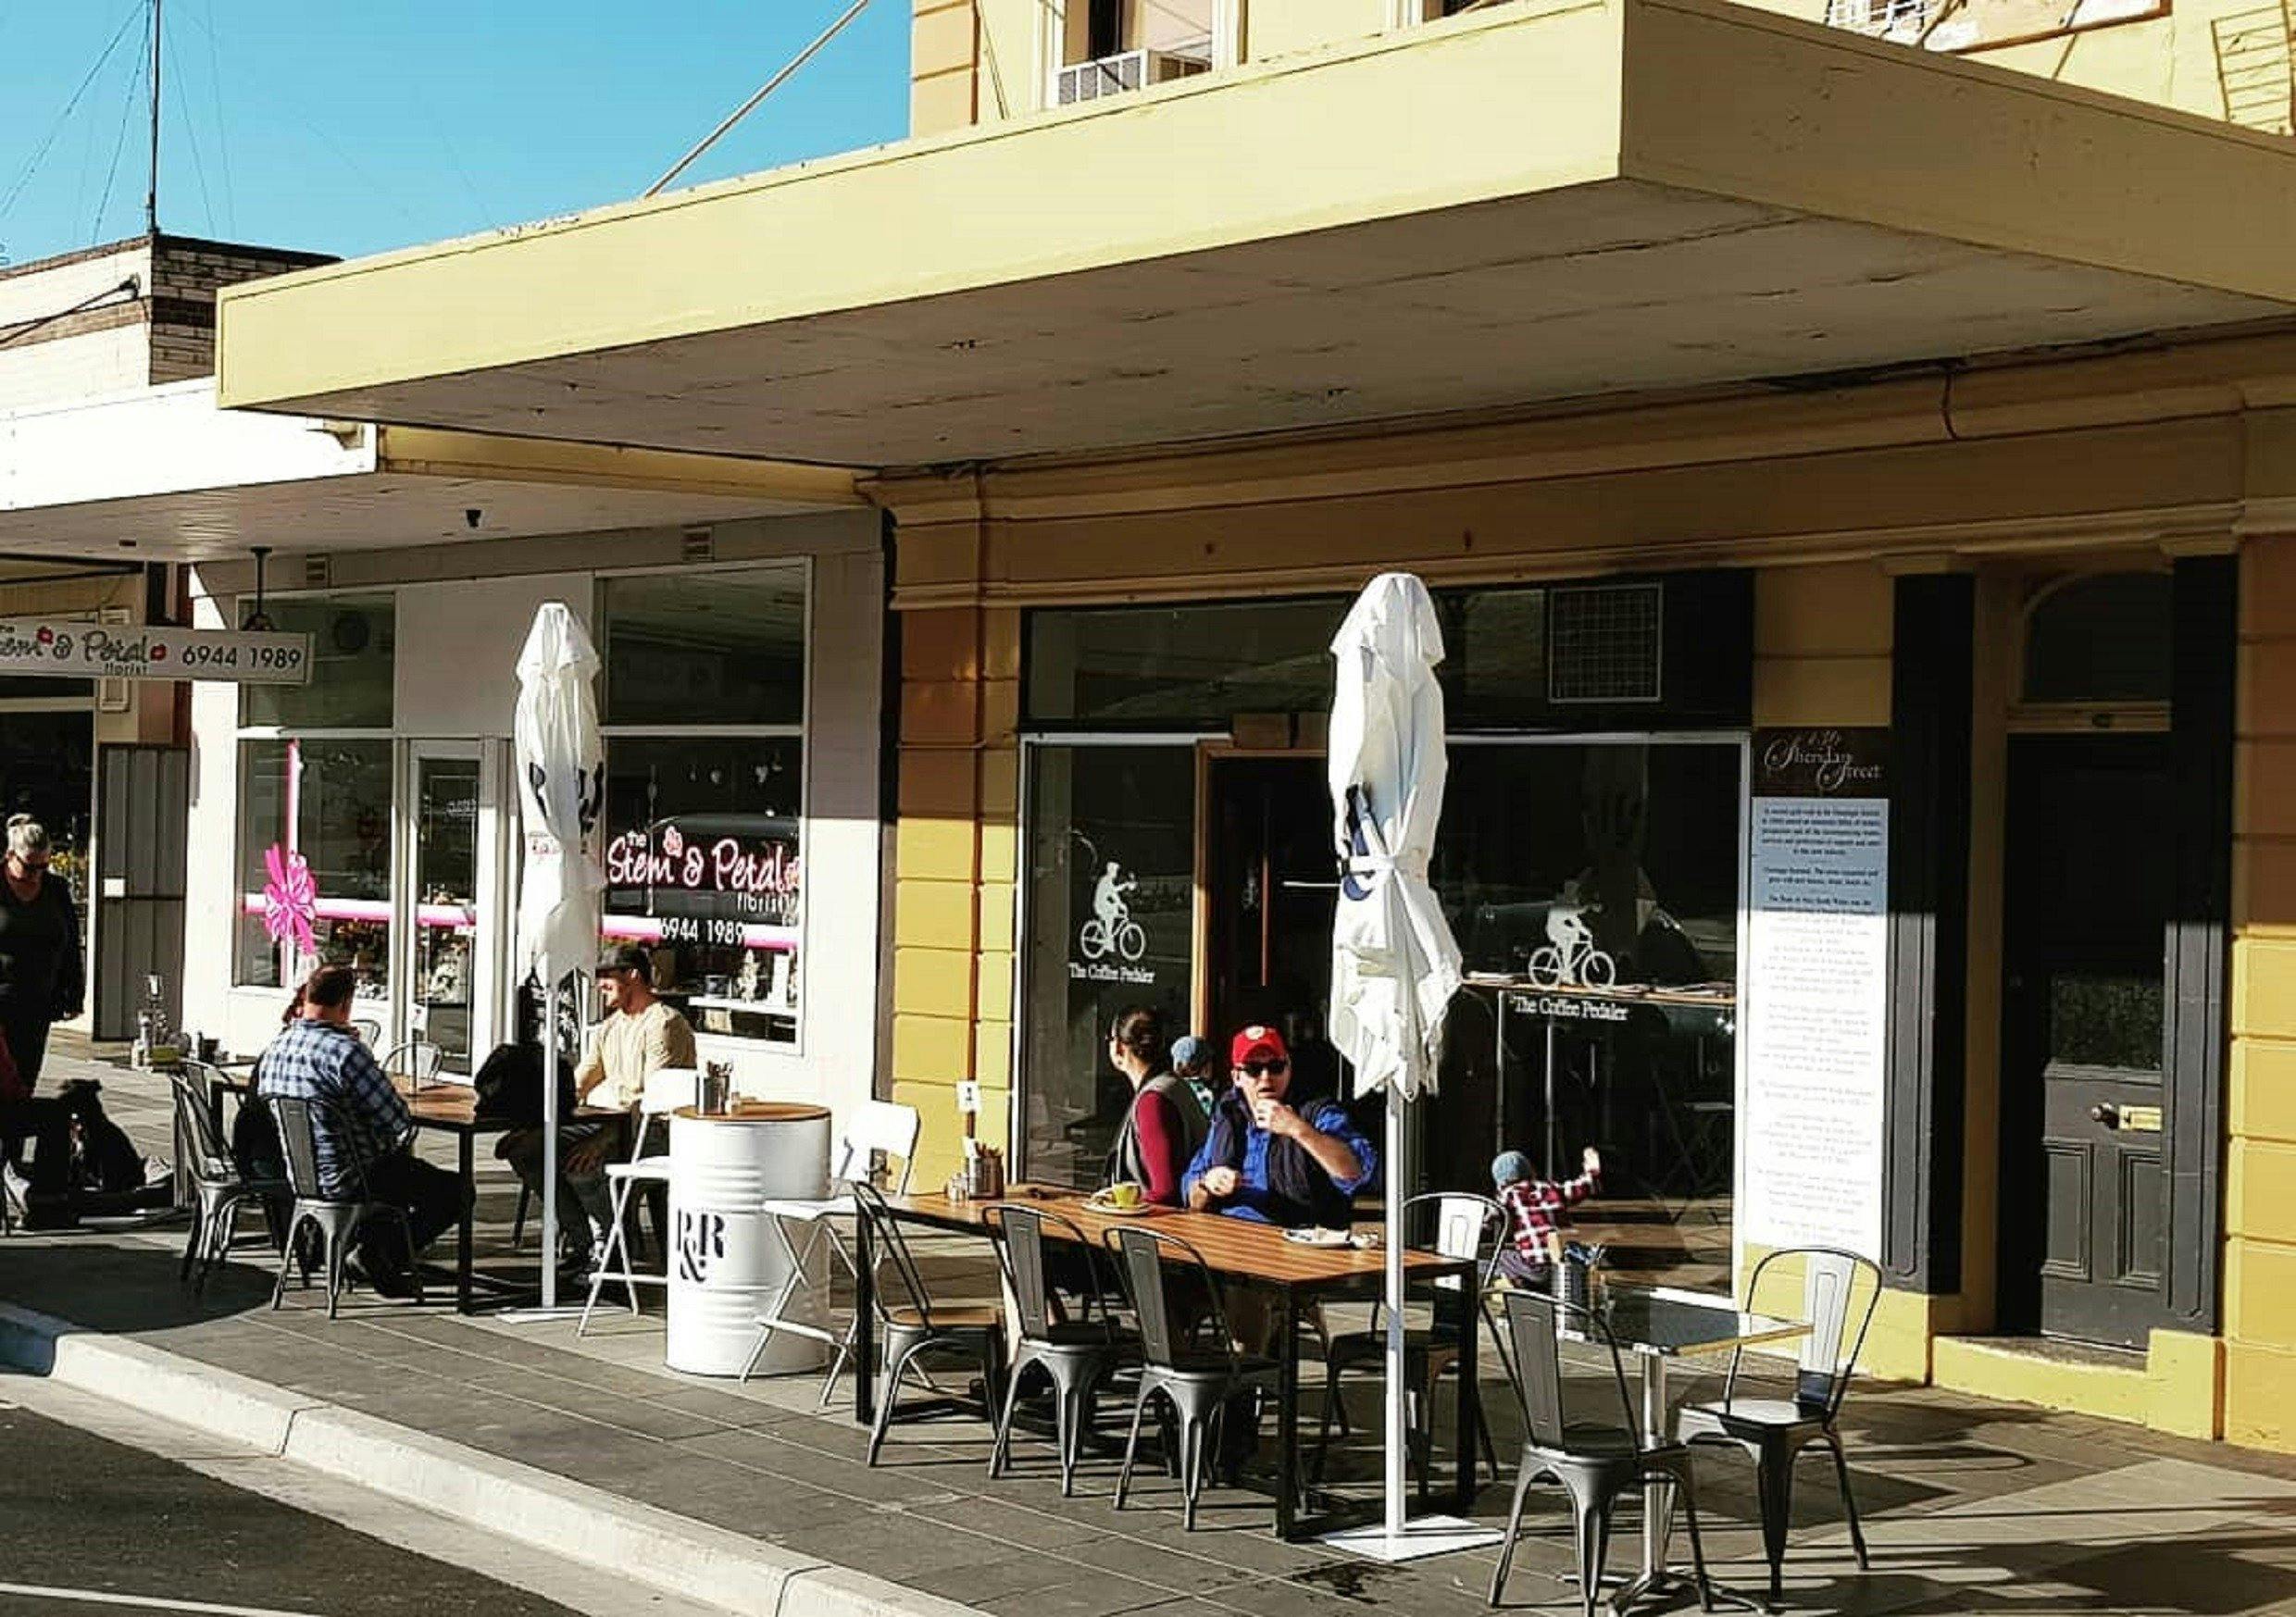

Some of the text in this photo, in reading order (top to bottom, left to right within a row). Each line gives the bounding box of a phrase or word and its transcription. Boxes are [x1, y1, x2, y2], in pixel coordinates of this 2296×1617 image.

[182, 645, 303, 669] 6944 1989
[607, 836, 676, 883] Stem
[682, 846, 704, 887] &
[660, 917, 744, 943] 6944 1989
[1068, 962, 1087, 978] The
[1088, 964, 1119, 981] Coffee
[1513, 996, 1538, 1014] The
[1539, 998, 1580, 1017] Coffee
